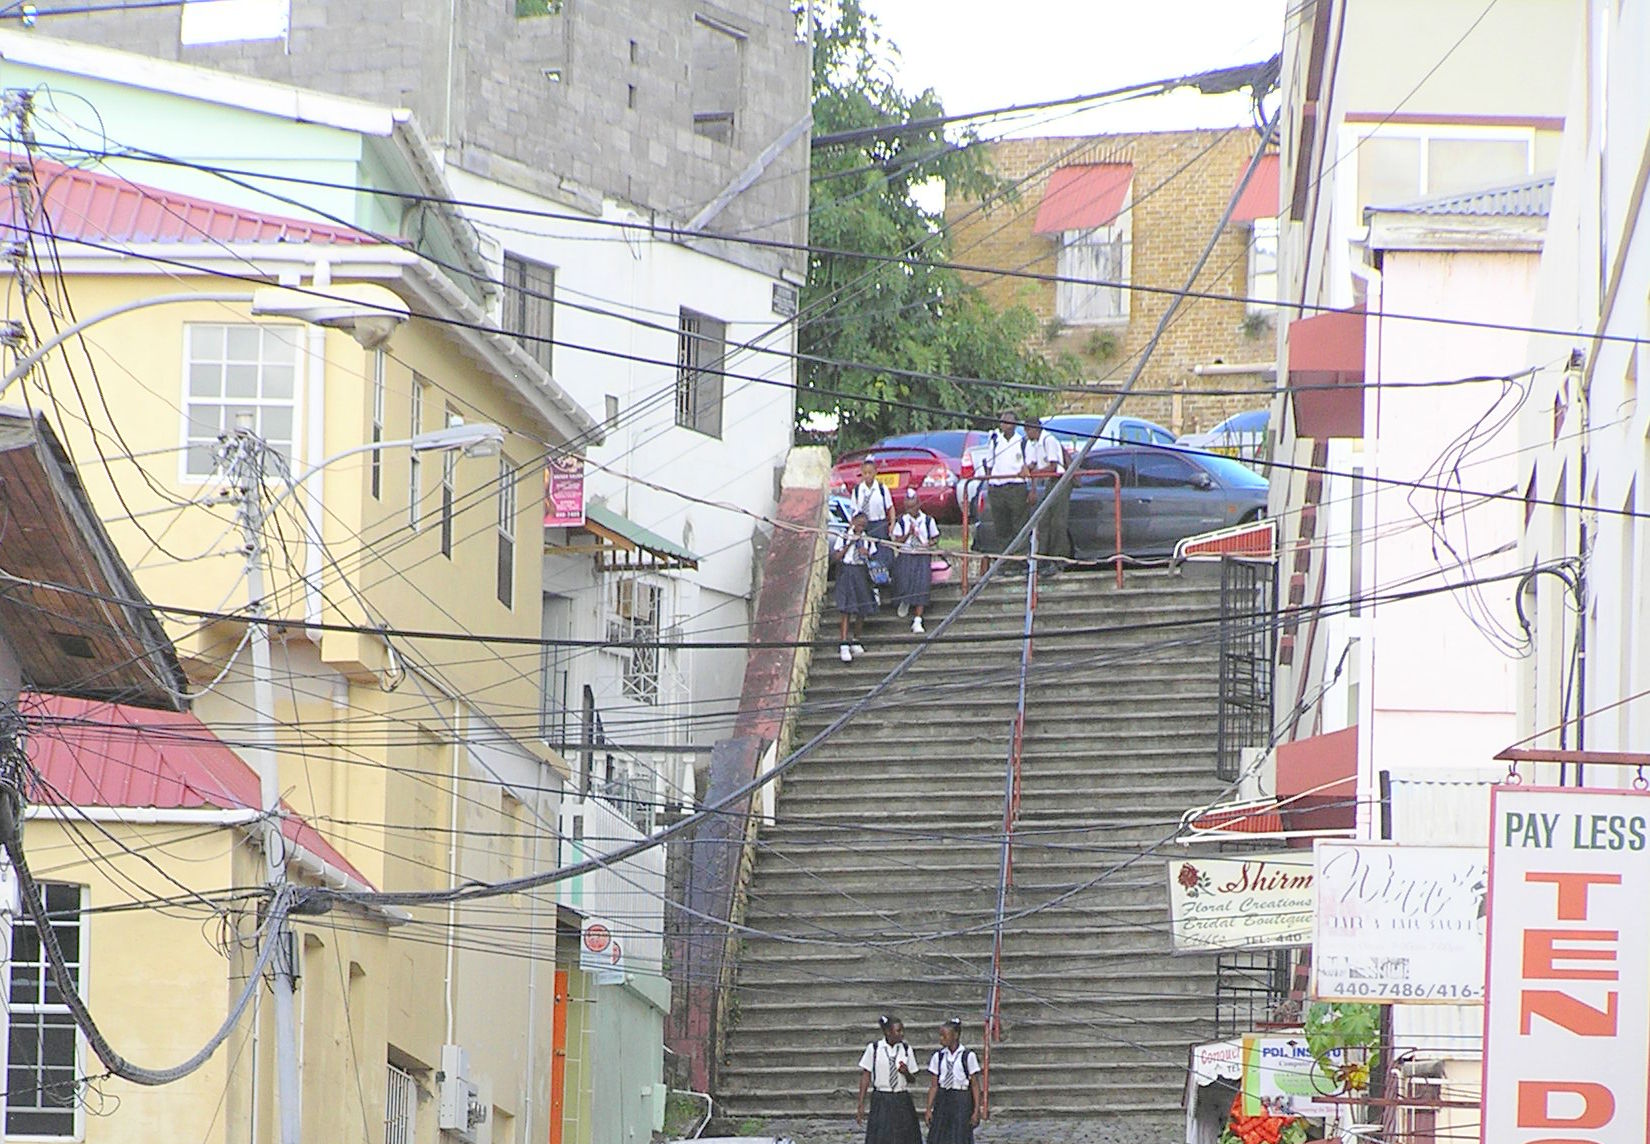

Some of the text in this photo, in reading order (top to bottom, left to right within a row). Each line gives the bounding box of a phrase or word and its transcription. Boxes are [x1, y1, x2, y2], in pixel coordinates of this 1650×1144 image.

[1505, 812, 1646, 851] PAY LESS
[1182, 897, 1312, 916] Floral Creations
[1183, 913, 1313, 931] Bridal Boutique
[1520, 872, 1622, 1037] TEN
